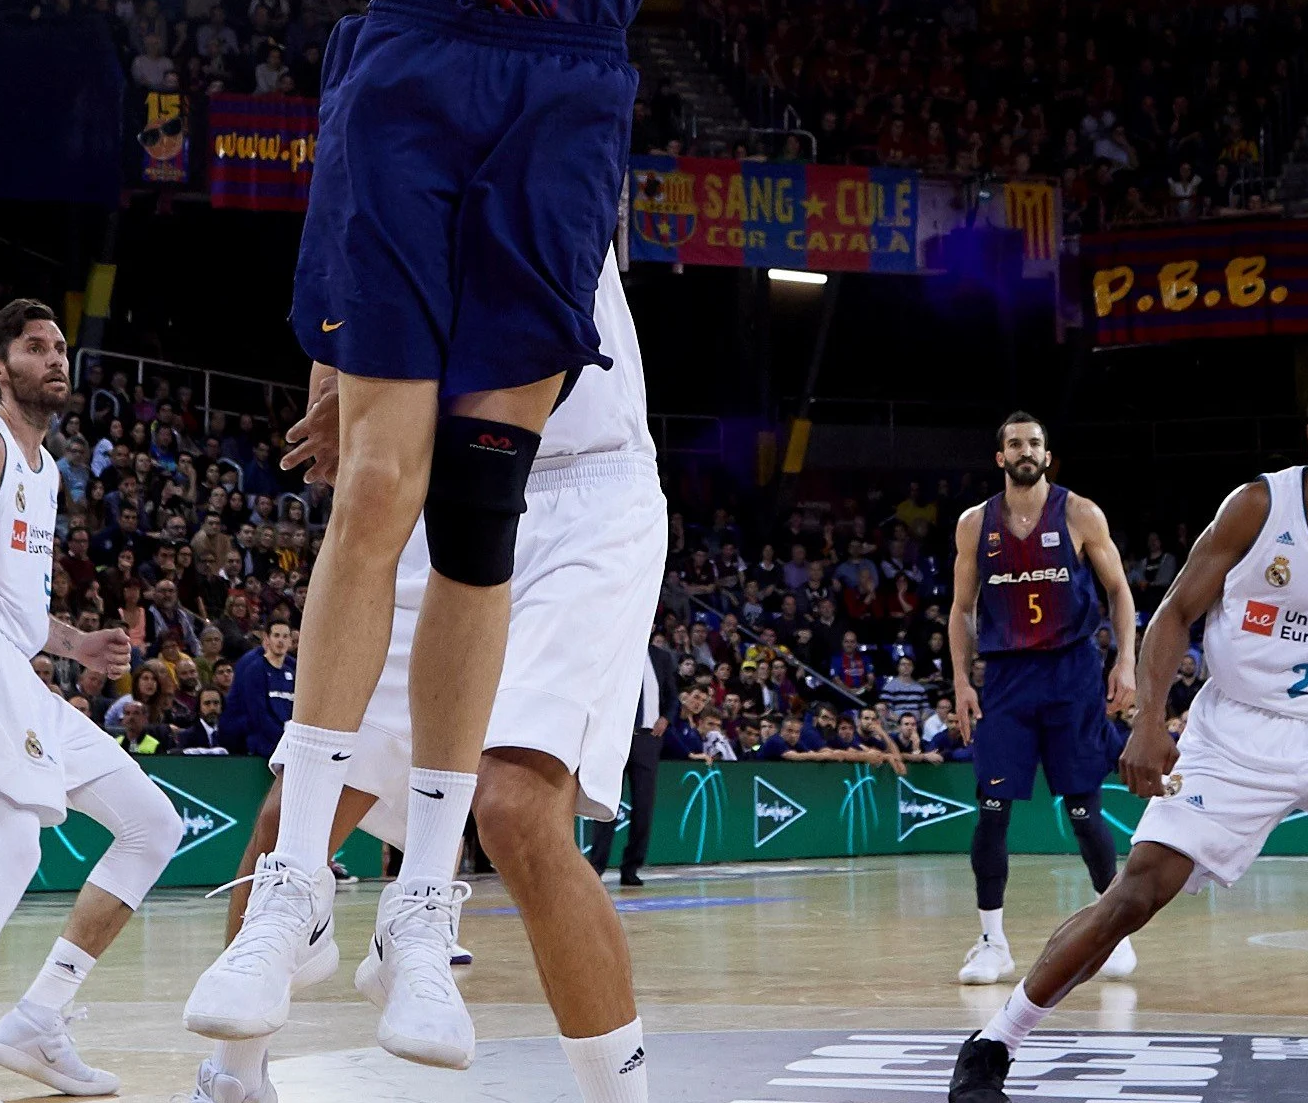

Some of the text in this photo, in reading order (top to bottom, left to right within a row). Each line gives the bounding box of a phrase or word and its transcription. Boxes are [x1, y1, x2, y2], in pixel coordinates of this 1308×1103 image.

[703, 172, 794, 223] SANG
[706, 226, 766, 250] COR
[1092, 254, 1289, 317] P.B.B.
[1008, 567, 1070, 583] LASSA
[1028, 593, 1043, 624] 5
